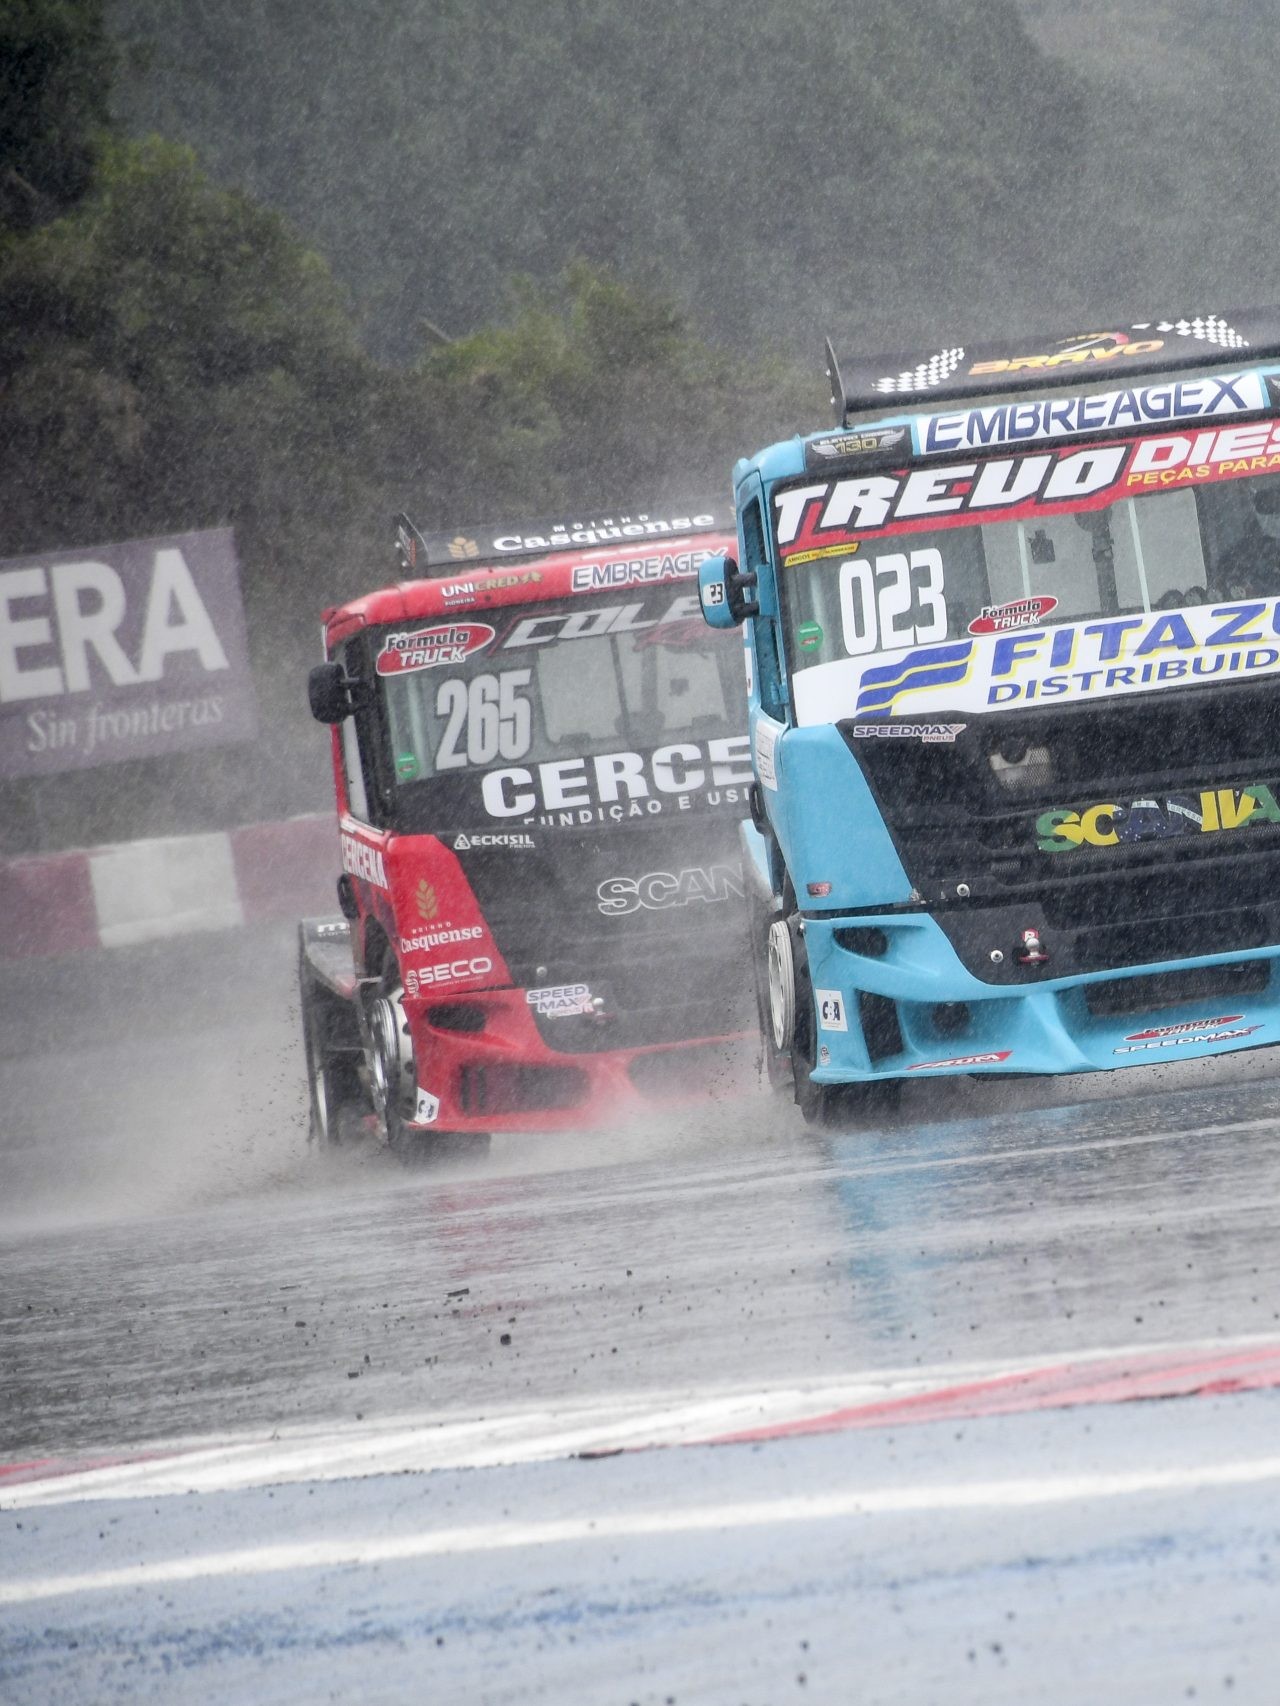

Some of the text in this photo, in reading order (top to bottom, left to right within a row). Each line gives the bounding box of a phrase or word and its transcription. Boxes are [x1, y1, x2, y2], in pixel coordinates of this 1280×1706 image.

[968, 340, 1165, 376] BRAVO
[926, 375, 1248, 452] EMBREAGEX
[836, 437, 878, 454] 130
[1126, 464, 1211, 487] PEÇAS
[493, 514, 714, 551] Casquense
[441, 577, 518, 597] UNICRED
[840, 547, 945, 656] 023
[993, 612, 1040, 630] TRUCK
[400, 646, 466, 667] TRUCK
[436, 669, 532, 771] 265
[854, 724, 955, 736] SPEEDMAX
[679, 795, 691, 809] E
[401, 926, 483, 953] Casquense
[420, 957, 492, 985] SECO
[529, 986, 586, 1001] SPEED
[540, 998, 578, 1010] MAX
[1112, 1029, 1250, 1055] SPEEDMAX
